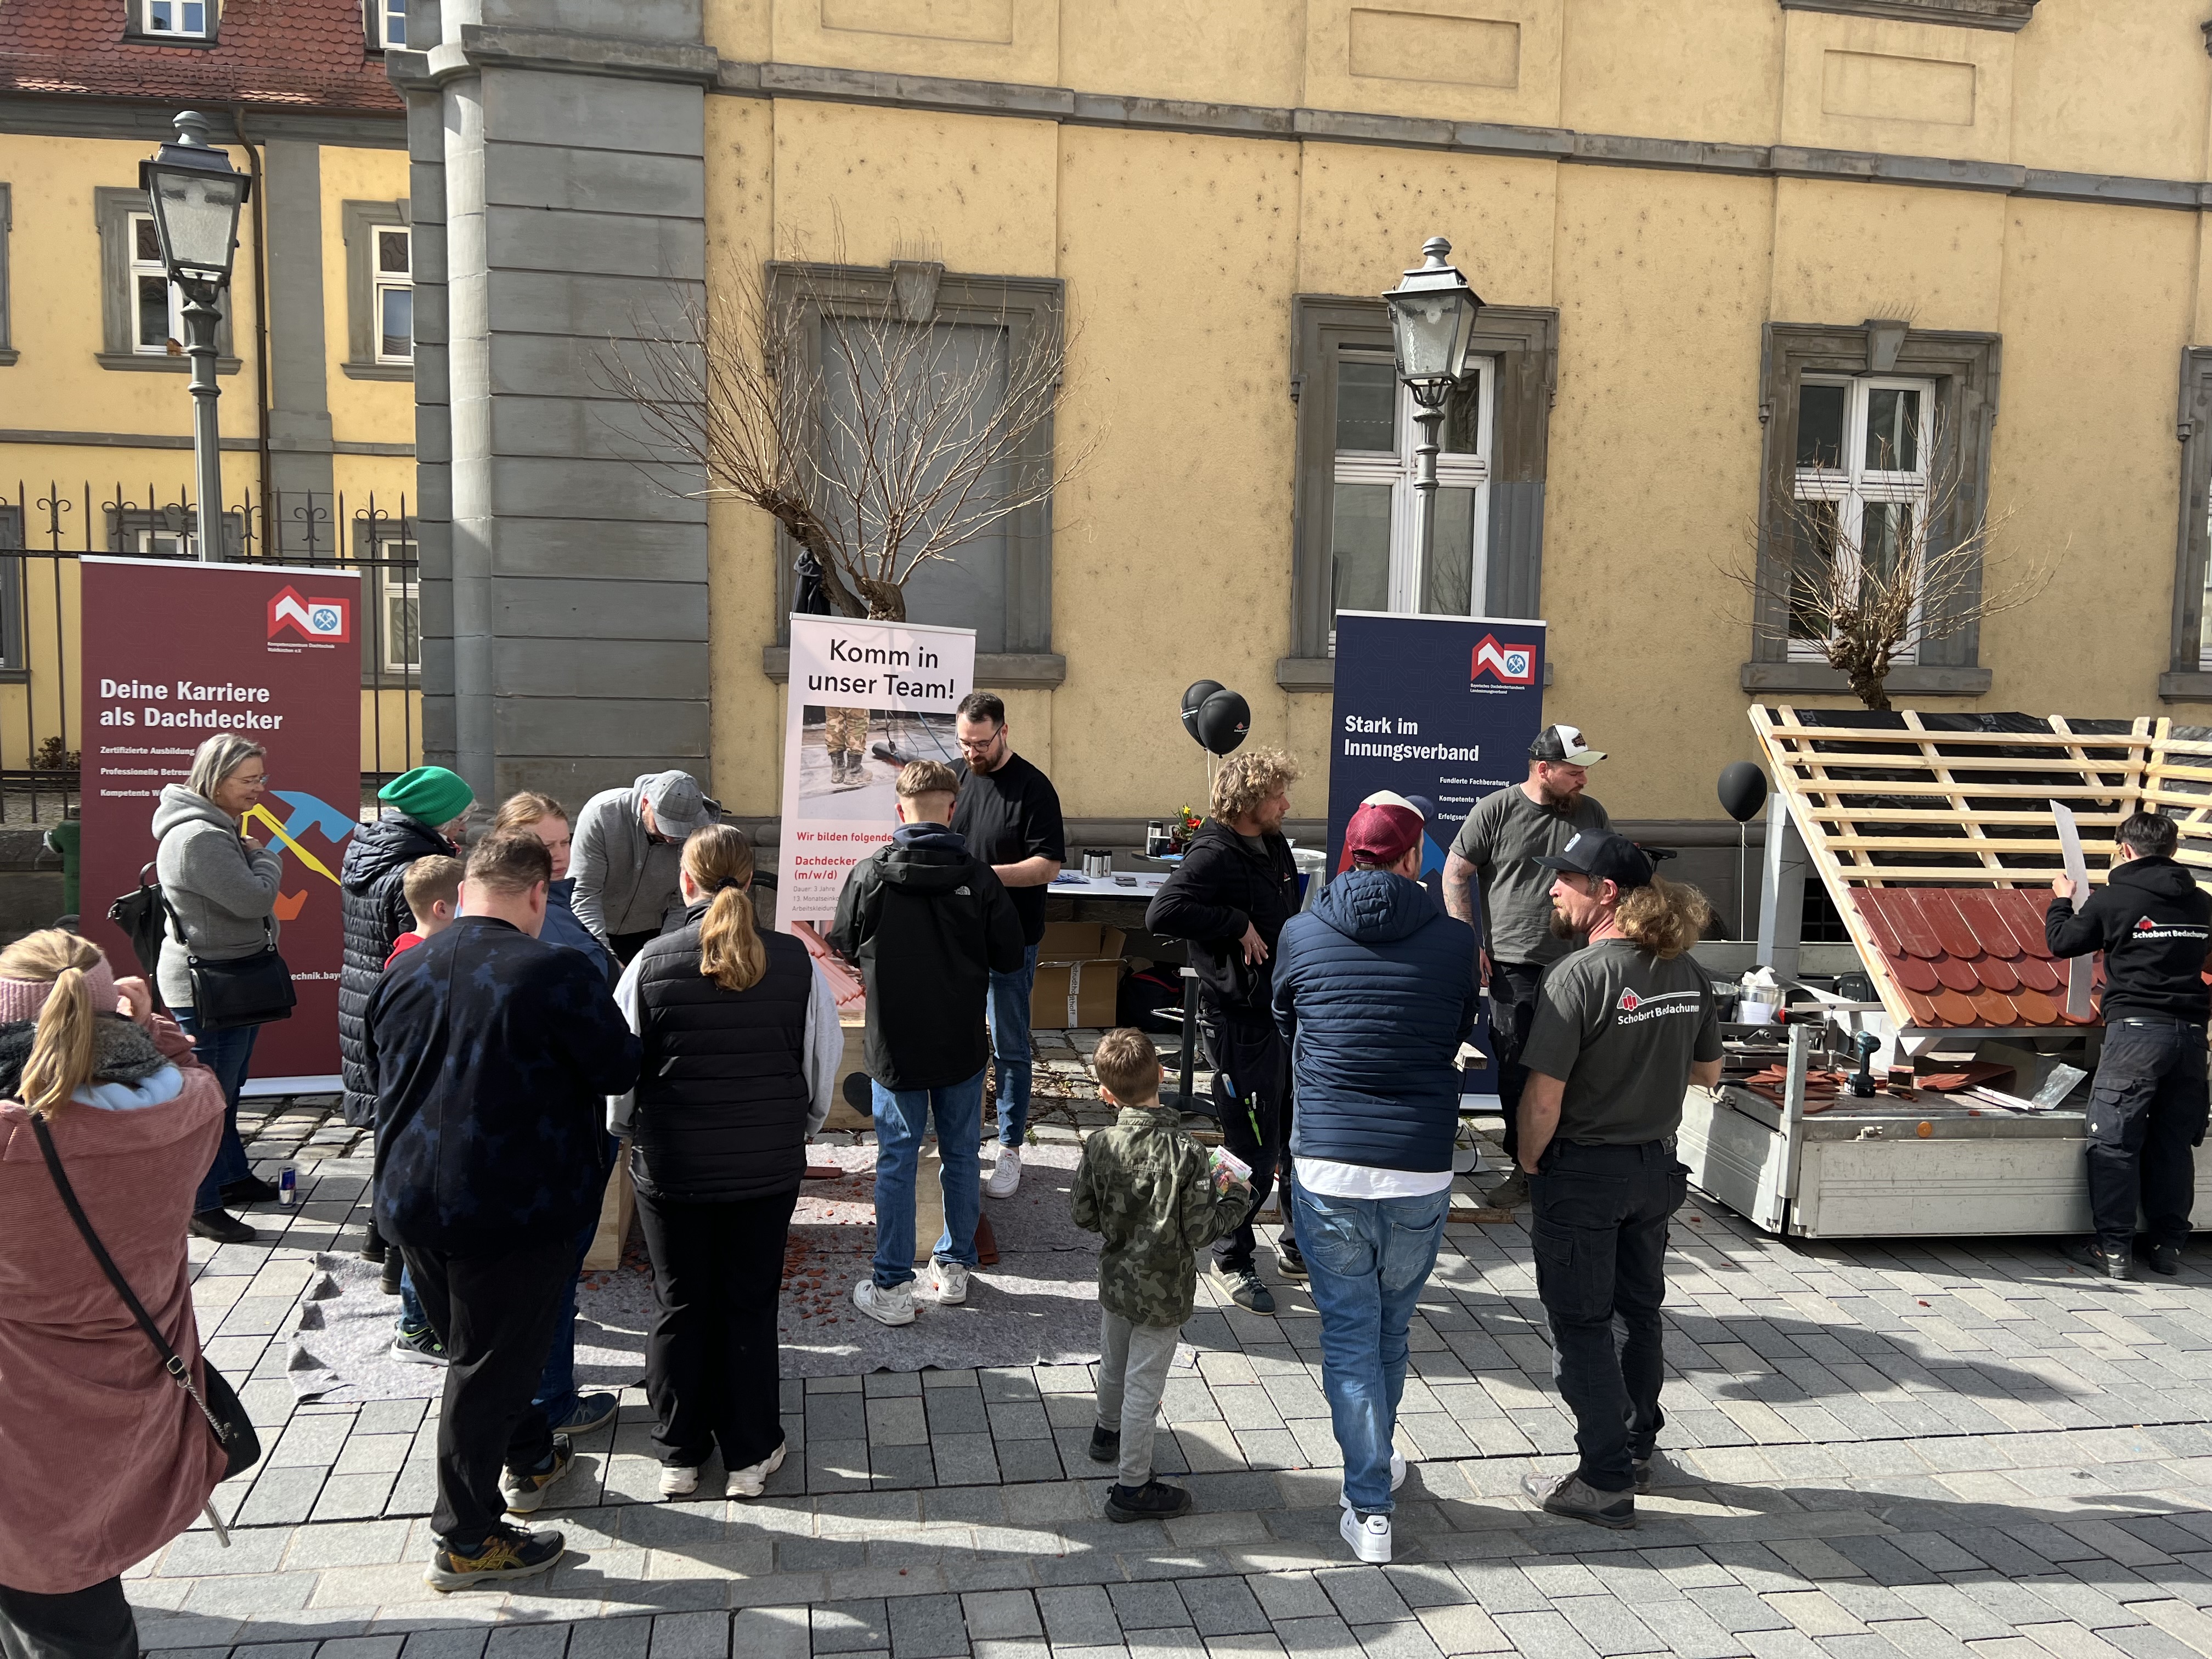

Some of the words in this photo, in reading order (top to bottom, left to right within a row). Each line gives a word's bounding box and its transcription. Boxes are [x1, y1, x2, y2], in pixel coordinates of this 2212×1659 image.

[830, 639, 910, 666] Komm
[918, 646, 938, 668] in
[100, 679, 168, 700] Deine
[177, 681, 270, 703] Karriere
[808, 675, 877, 694] unser
[883, 674, 954, 699] Team!
[99, 707, 136, 726] als
[144, 707, 283, 730] Dachdecker
[1345, 715, 1392, 733] Stark
[1397, 718, 1418, 735] im
[100, 746, 148, 754] Zertifizierte
[150, 747, 195, 757] Ausbildung
[1344, 738, 1479, 761] Innungsverband
[1469, 778, 1510, 787] Fachberatung
[100, 789, 150, 798] Kompetente
[797, 832, 815, 840] Wir
[817, 832, 848, 841] bilden
[851, 832, 893, 844] folgende
[795, 856, 857, 866] Dachdecker
[794, 870, 837, 880] (m/w/d)
[2132, 930, 2172, 939] Schobert
[290, 972, 341, 980] echnik.bay
[1618, 1010, 1655, 1025] Schobert
